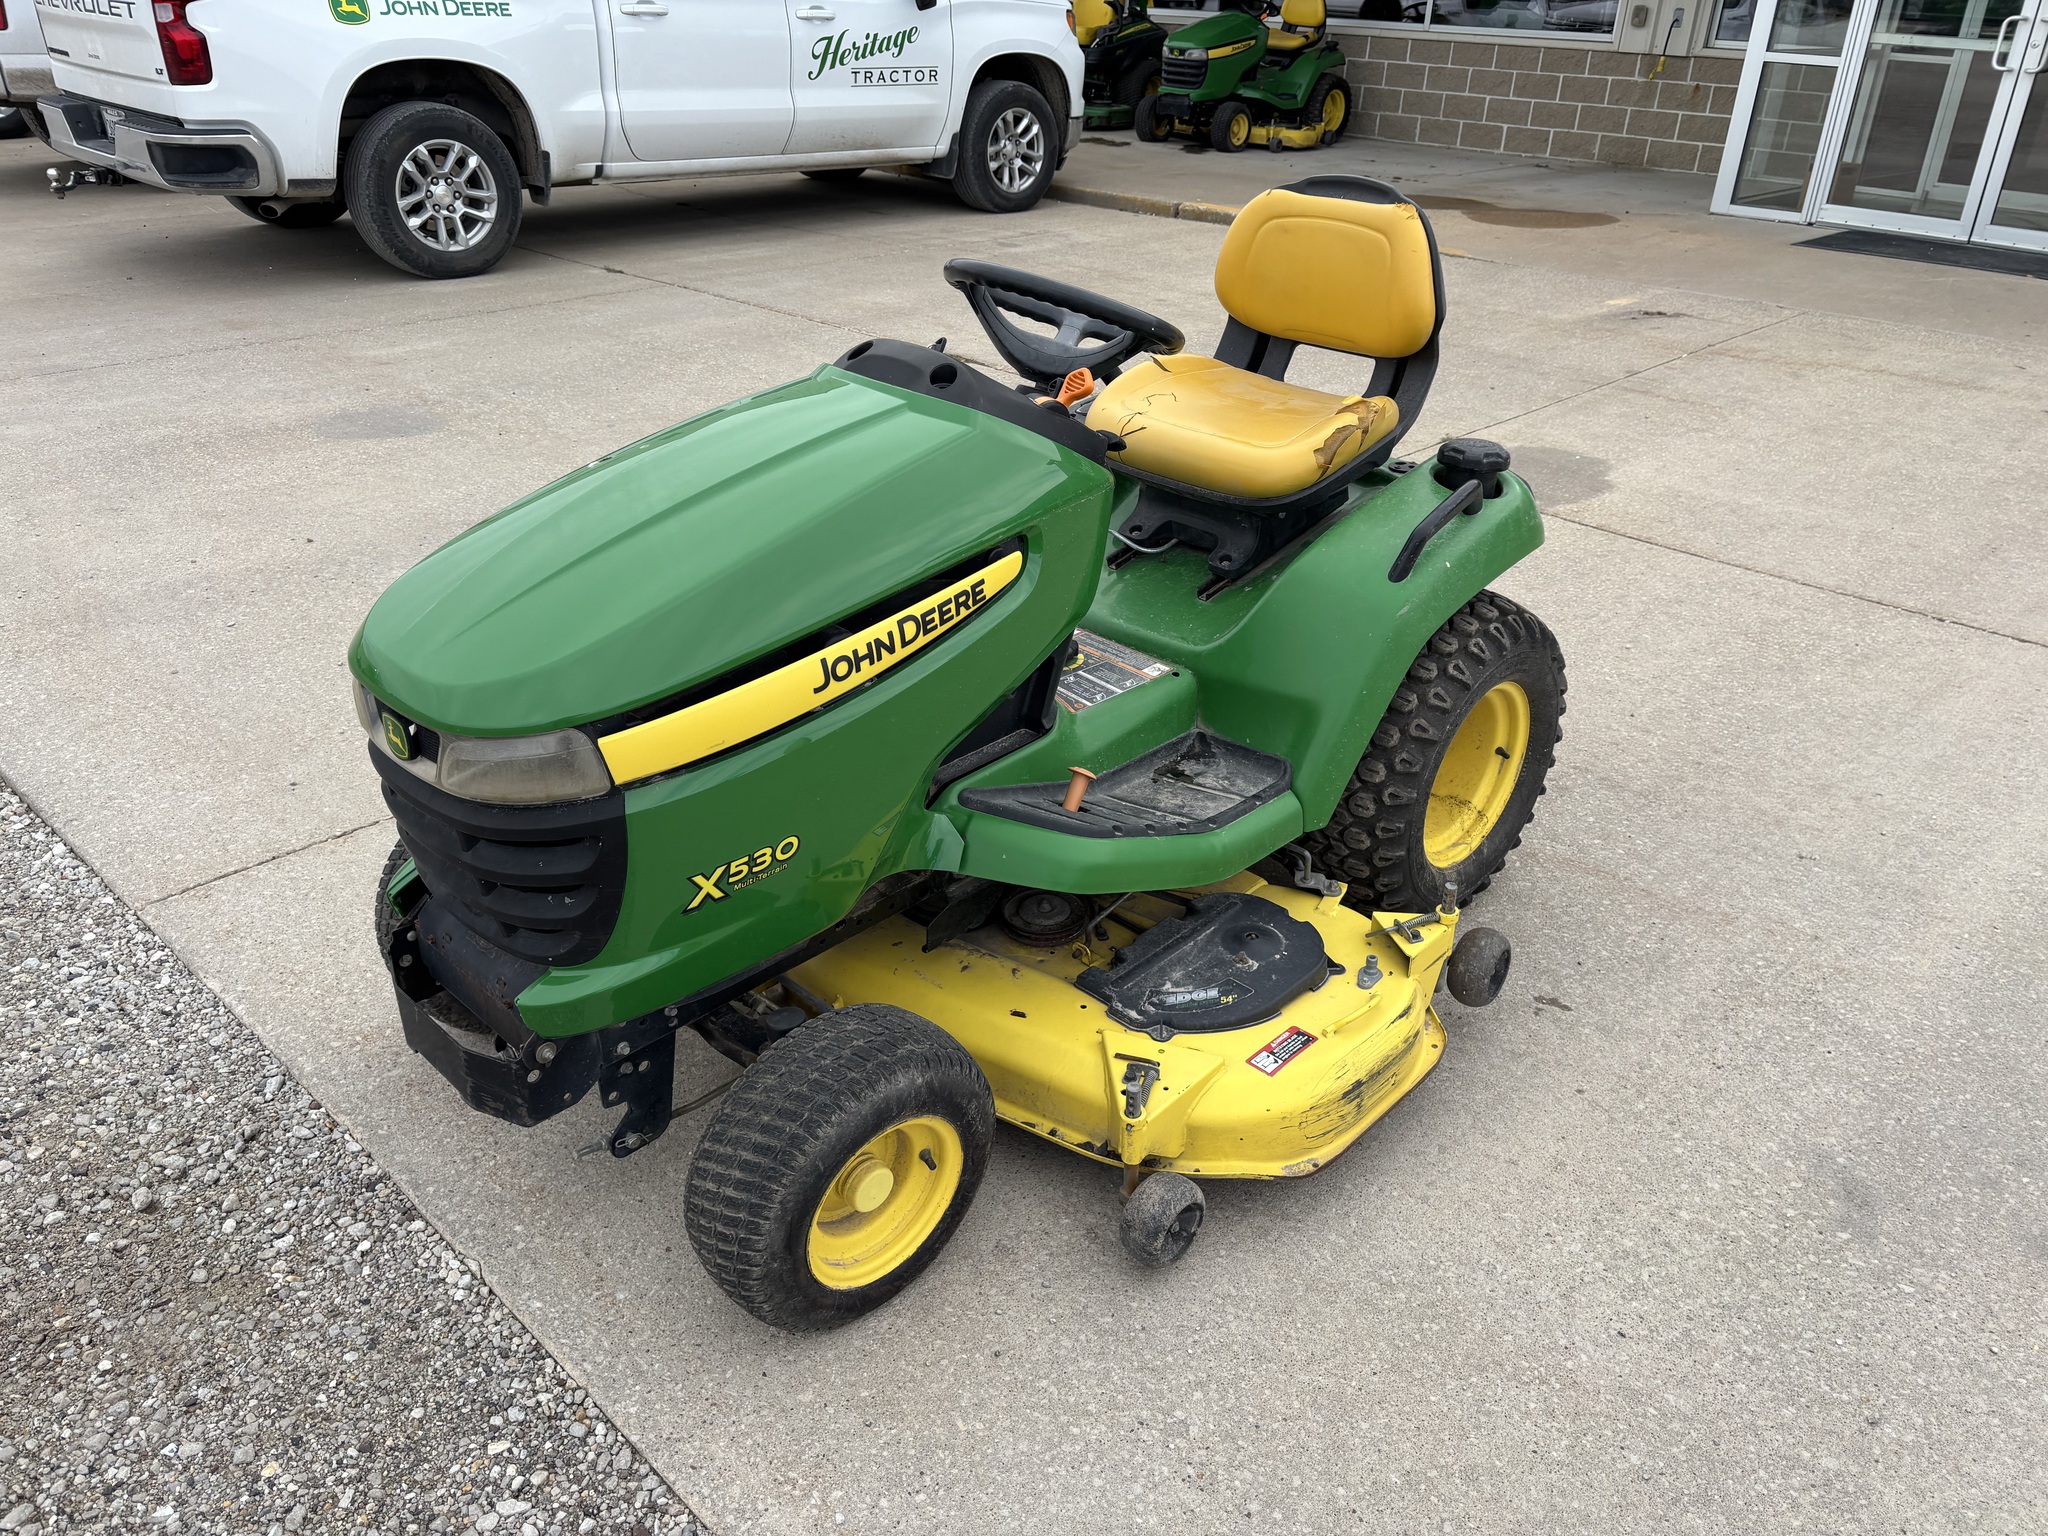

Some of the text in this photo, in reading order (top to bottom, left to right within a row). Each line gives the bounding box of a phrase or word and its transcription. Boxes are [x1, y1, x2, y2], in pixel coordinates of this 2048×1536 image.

[380, 0, 512, 17] JOHN DEERE
[808, 26, 920, 80] Heritage
[851, 70, 938, 83] TRACTOR
[813, 578, 987, 694] JOHN DEERE
[682, 835, 800, 914] X530
[733, 863, 788, 891] Multi-Terrain
[1164, 988, 1219, 1006] EDGE
